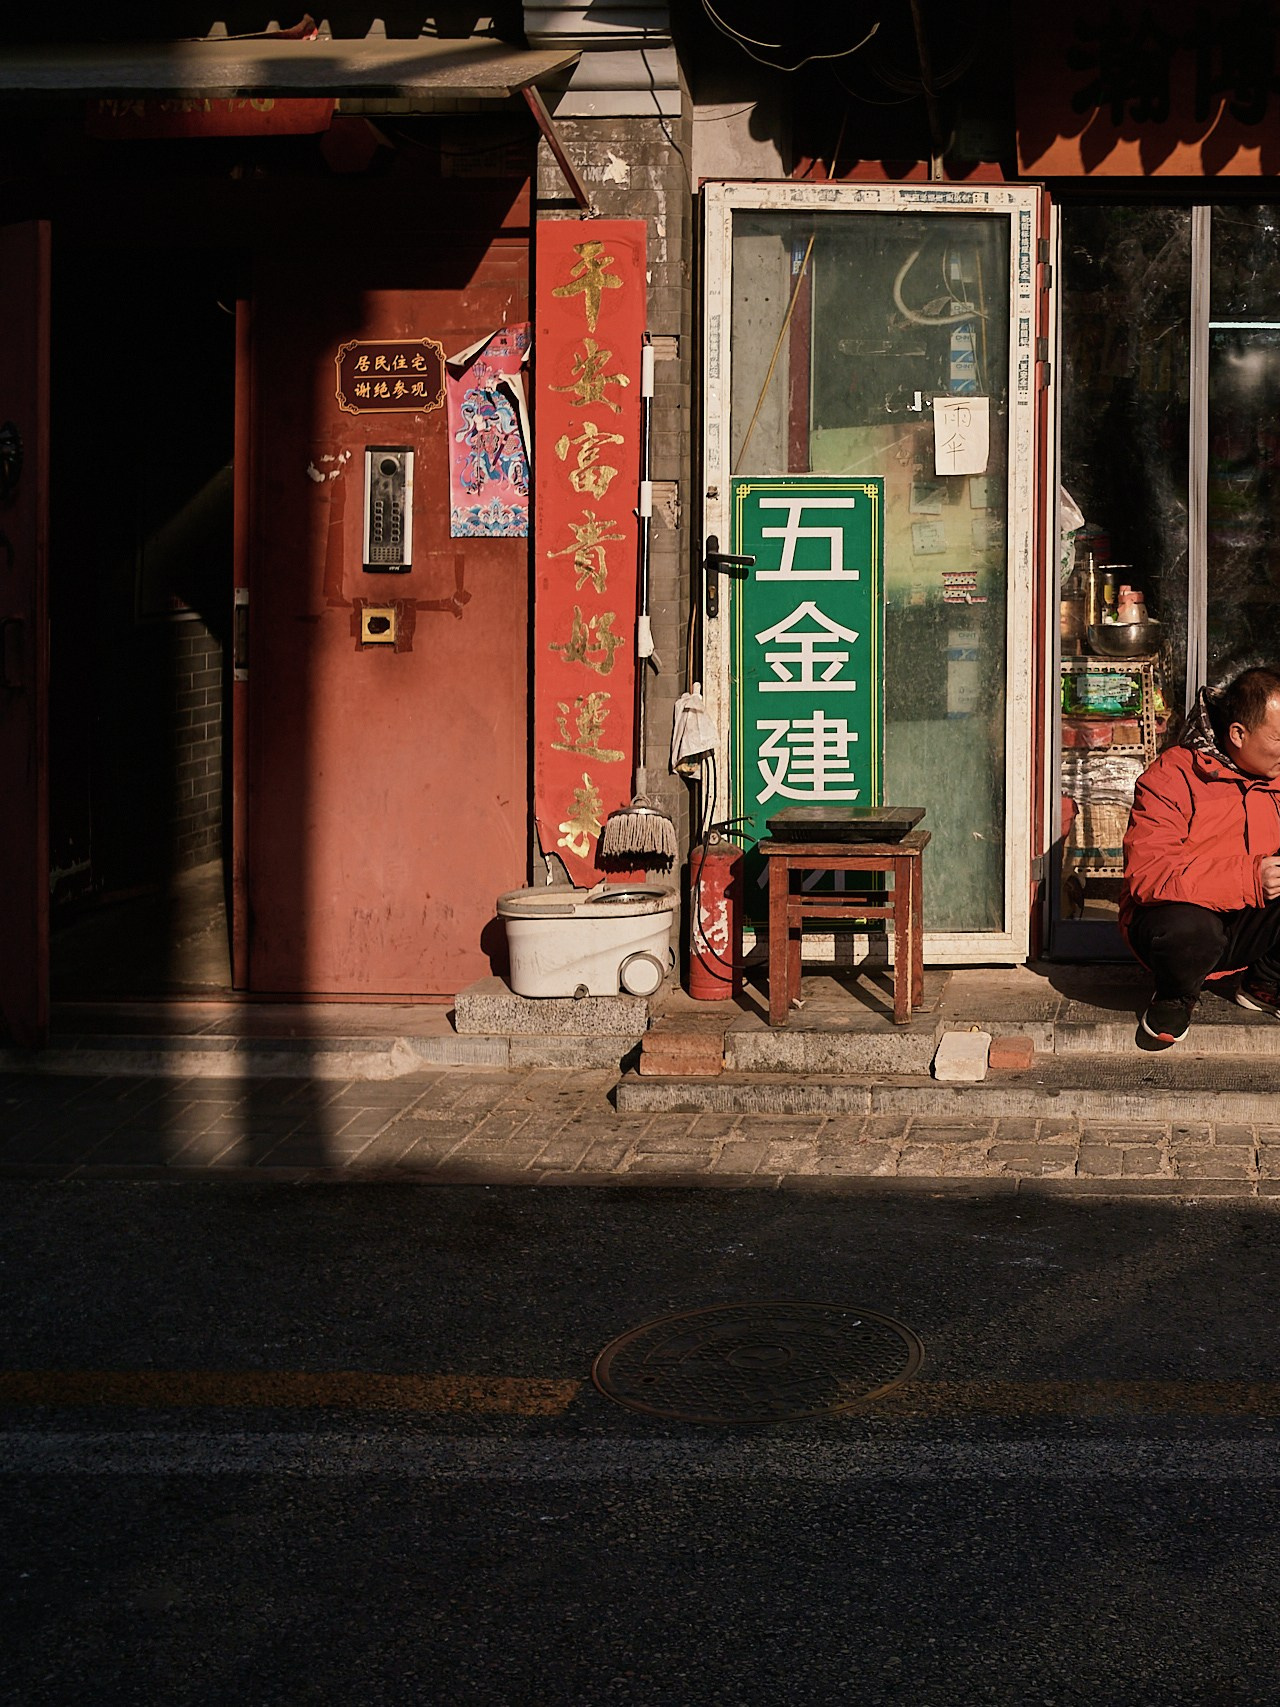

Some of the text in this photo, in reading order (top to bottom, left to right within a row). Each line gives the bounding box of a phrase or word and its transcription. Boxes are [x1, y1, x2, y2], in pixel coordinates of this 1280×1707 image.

[354, 353, 428, 372] 居民住宅
[354, 379, 428, 399] 谢绝参观
[942, 401, 971, 471] 雨伞
[756, 497, 861, 906] 五金建
